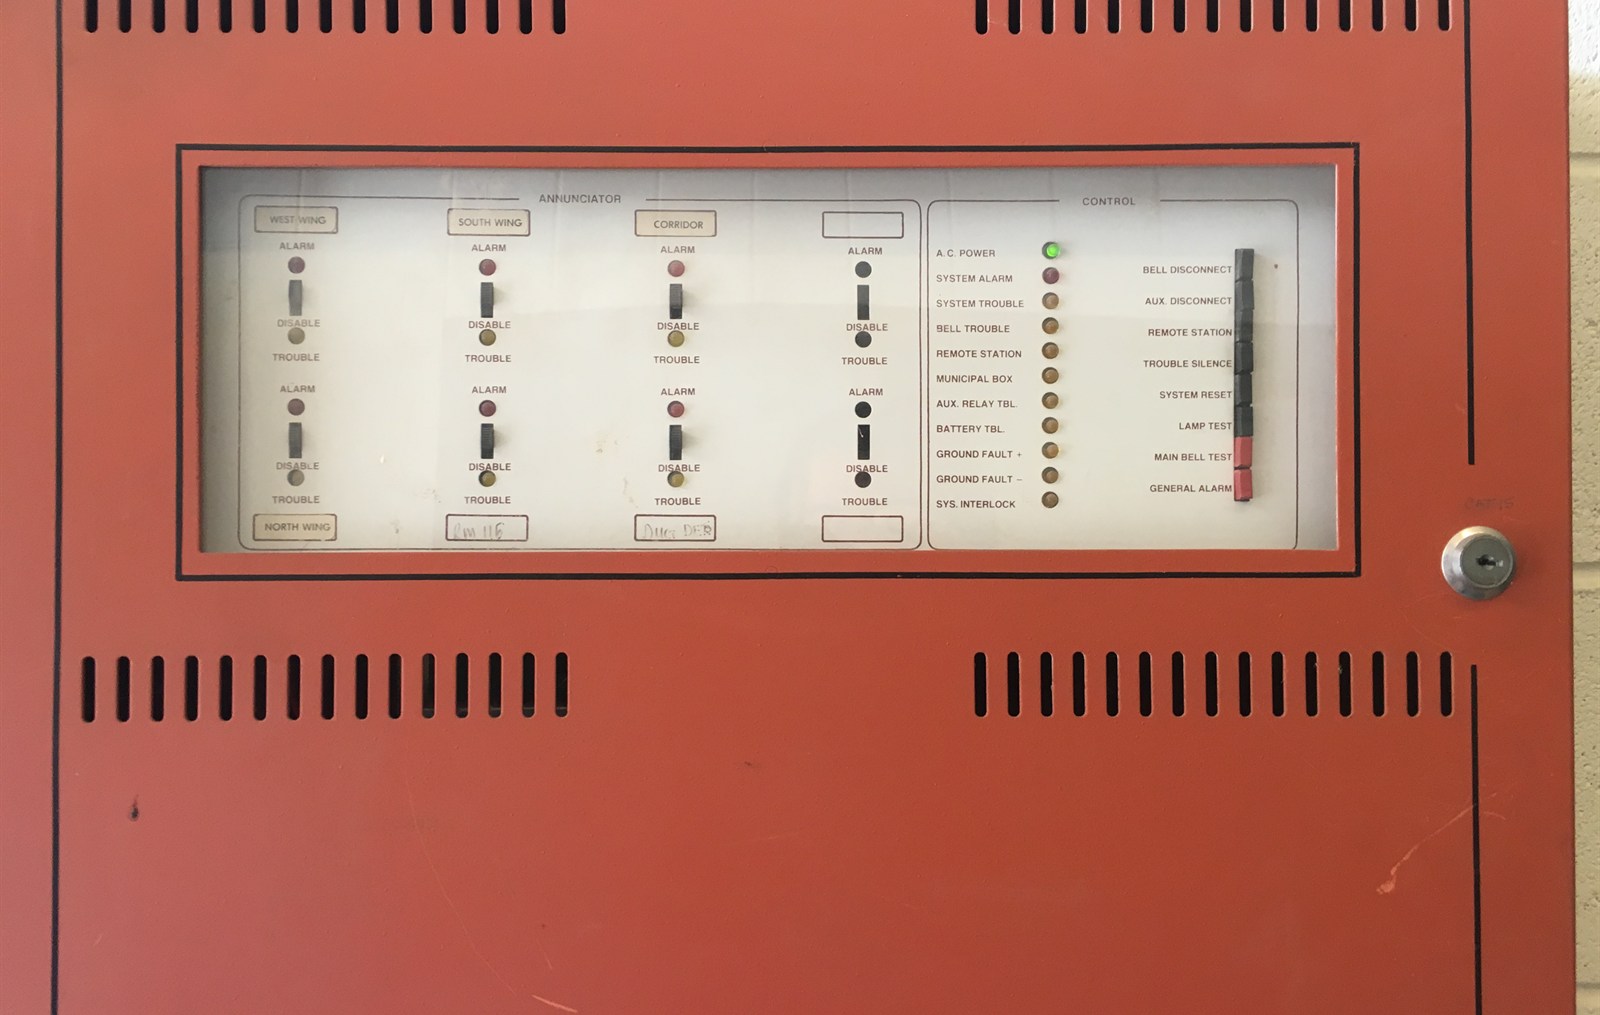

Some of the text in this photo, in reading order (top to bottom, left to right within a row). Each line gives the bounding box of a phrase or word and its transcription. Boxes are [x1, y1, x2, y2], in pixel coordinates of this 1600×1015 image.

[539, 193, 622, 204] ANNUNCIATOR
[1082, 197, 1136, 206] CONTROL
[270, 215, 327, 225] WEST WING
[458, 218, 523, 227] SOUTH WING
[654, 220, 704, 229] CORRIDOR
[279, 242, 315, 250] ALARM
[471, 244, 507, 252] ALARM
[660, 245, 696, 254] ALARM
[848, 247, 883, 256] ALARM
[960, 250, 996, 258] POWER
[1143, 265, 1233, 274] BELL DISCONNECT
[936, 274, 1013, 283] SYSTEM ALARM
[936, 299, 1025, 308] SYSTEM TROUBLE
[1145, 297, 1233, 306] AUX. DISCONNECT
[277, 319, 321, 328] DISABLE
[468, 321, 511, 330] DISABLE
[657, 322, 700, 331] DISABLE
[846, 323, 888, 332] DISABLE
[936, 325, 1011, 333] BELL TROUBLE
[1148, 328, 1233, 337] REMOTE STATION
[273, 353, 320, 362] TROUBLE
[465, 354, 512, 363] TROUBLE
[936, 350, 1022, 358] REMOTE STATION
[654, 356, 701, 364] TROUBLE
[842, 357, 888, 365] TROUBLE
[1143, 359, 1233, 368] TROUBLE SILENCE
[936, 375, 1013, 383] MUNICIPAL BOX
[280, 385, 316, 393] ALARM
[472, 386, 507, 394] ALARM
[661, 388, 696, 396] ALARM
[849, 388, 884, 397] ALARM
[1159, 390, 1233, 399] SYSTEM RESET
[936, 400, 1019, 408] AUX. RELAY TBL.
[936, 425, 1006, 433] BATTERY TBL.
[1179, 421, 1233, 430] LAMP TEST
[936, 450, 980, 459] GROUND
[982, 450, 1013, 459] FAULT
[1154, 453, 1233, 461] MAIN BELL TEST
[276, 461, 320, 471] DISABLE
[469, 463, 512, 472] DISABLE
[658, 464, 701, 473] DISABLE
[846, 464, 888, 473] DISABLE
[936, 475, 980, 484] GROUND
[982, 475, 1013, 484] FAULT
[1149, 484, 1233, 493] GENERAL ALARM
[272, 495, 320, 504] TROUBLE
[464, 496, 511, 505] TROUBLE
[655, 497, 701, 506] TROUBLE
[842, 497, 888, 506] TROUBLE
[936, 500, 1016, 509] SYS. INTERLOCK
[265, 523, 331, 532] NORTH WING
